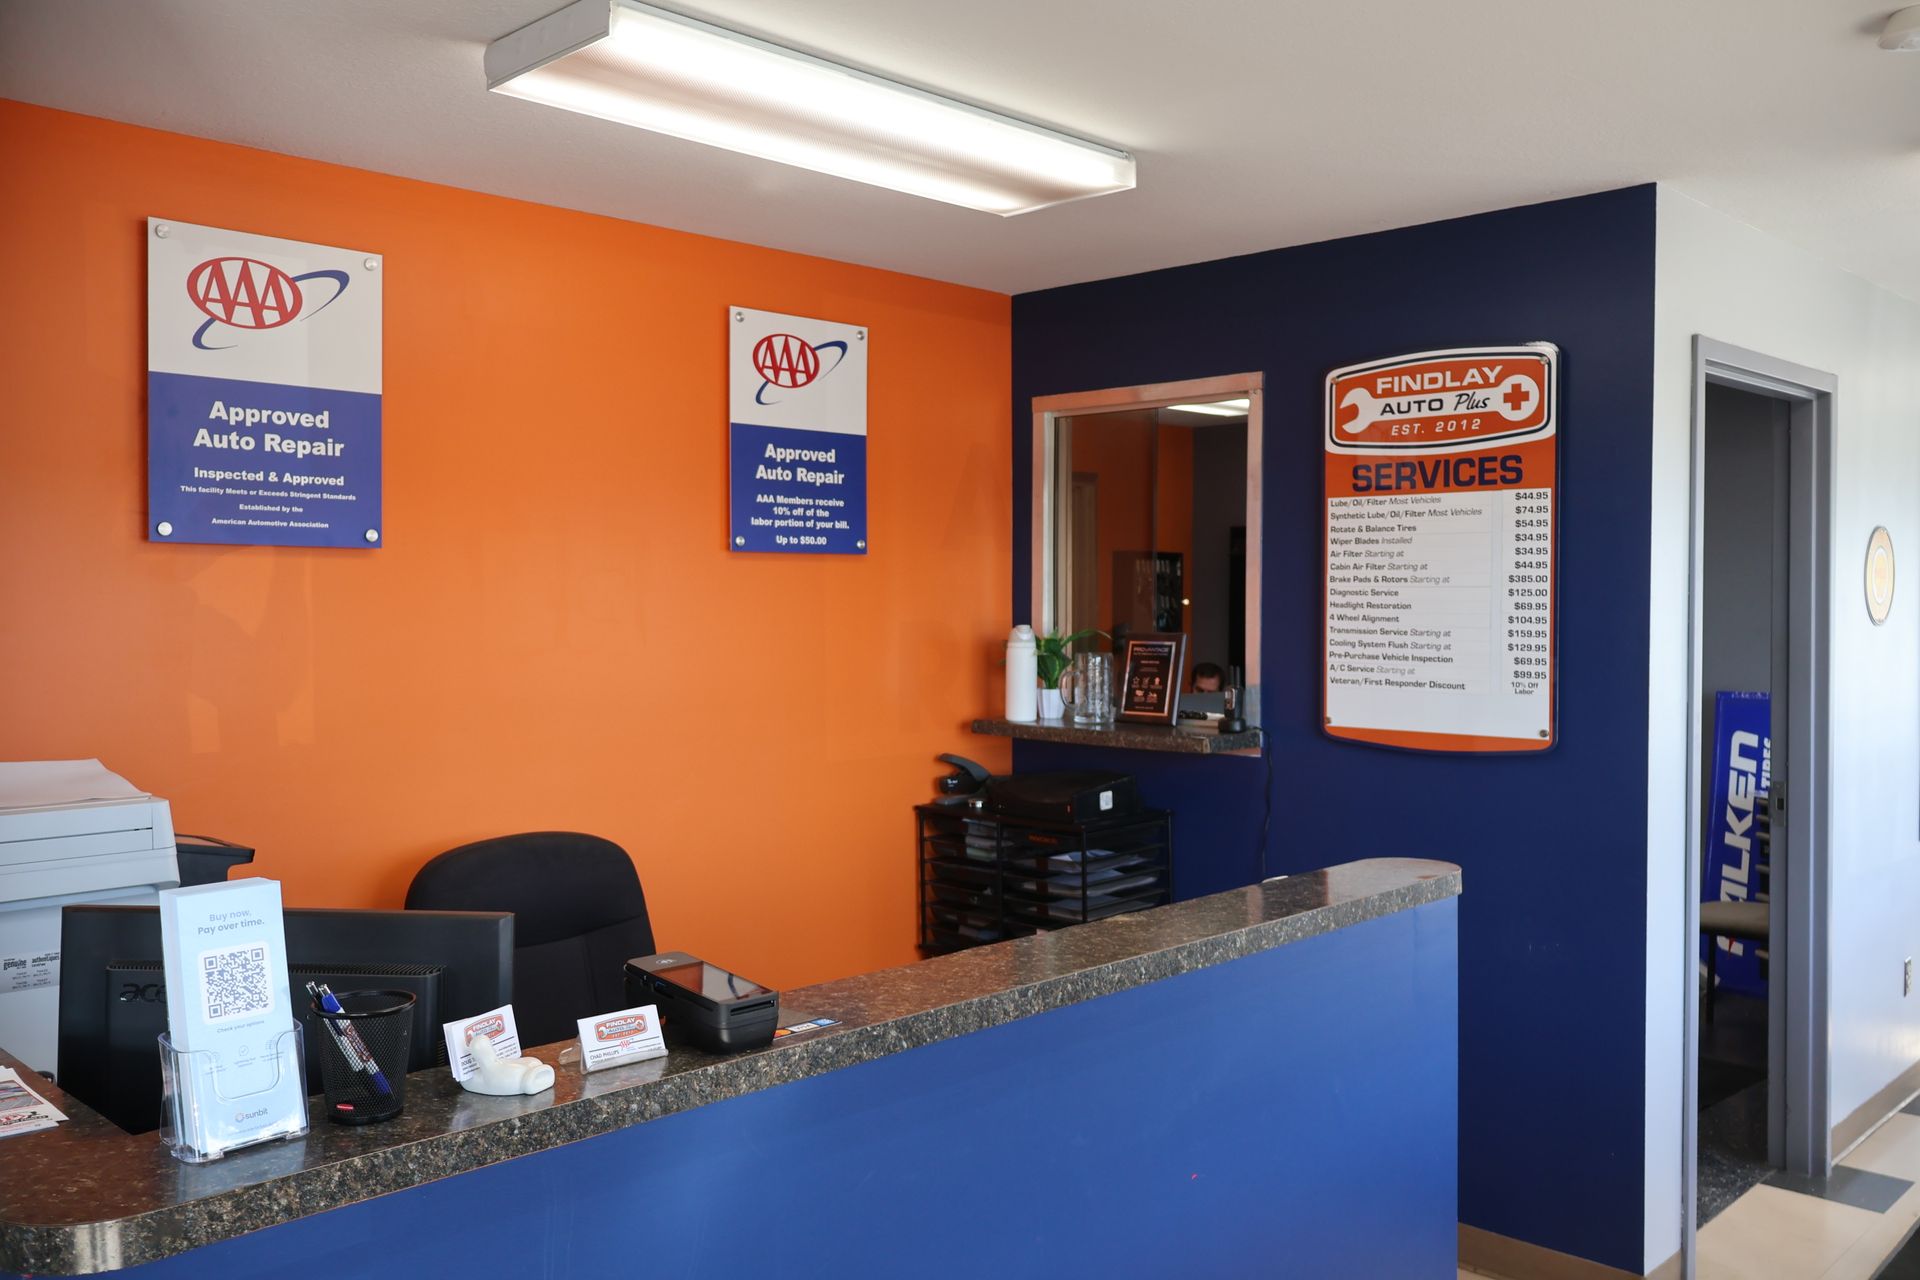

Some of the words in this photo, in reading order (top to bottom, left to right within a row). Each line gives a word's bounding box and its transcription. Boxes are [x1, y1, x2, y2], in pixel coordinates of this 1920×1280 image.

[193, 257, 297, 328] AAA
[757, 334, 816, 388] AAA
[1377, 365, 1503, 395] FINDLAY
[1380, 398, 1443, 416] AUTO
[1454, 392, 1490, 411] Plus
[209, 401, 329, 429] Approved
[1391, 422, 1425, 436] EST.
[1435, 419, 1481, 432] 2012
[193, 429, 255, 451] Auto
[264, 434, 344, 458] Repair
[765, 443, 835, 463] Approved
[194, 468, 264, 483] Inspected
[269, 471, 278, 482] &
[283, 472, 344, 486] Approved
[756, 465, 792, 481] Auto
[796, 468, 844, 486] Repair
[1352, 455, 1523, 492] SERVICES
[198, 486, 224, 496] facility
[290, 491, 320, 500] Stringent
[322, 493, 356, 501] Standards
[756, 494, 774, 504] AAA
[776, 495, 813, 506] Members
[815, 497, 844, 507] receive
[1330, 498, 1387, 507] Lube/Oil/Filter
[1388, 497, 1409, 505] Most
[1411, 496, 1441, 504] Vehicles
[1515, 491, 1548, 500] $44.95
[239, 503, 279, 512] Established
[281, 505, 290, 514] by
[773, 507, 790, 516] 10%
[792, 507, 804, 517] off
[806, 508, 814, 517] of
[816, 508, 829, 517] the
[1330, 511, 1365, 521] Synthetic
[1367, 509, 1426, 519] Lube/Oil/Filter
[1428, 509, 1449, 517] Most
[1450, 508, 1482, 516] Vehicles
[1516, 506, 1548, 514] $74.95
[212, 517, 245, 526] American
[248, 519, 287, 527] Automotive
[289, 520, 329, 528] Association
[751, 517, 773, 526] labor
[775, 518, 804, 528] portion
[806, 518, 814, 528] of
[816, 520, 833, 530] your
[835, 520, 849, 529] bill.
[1330, 525, 1356, 533] Rotate
[1515, 519, 1548, 528] $54.95
[776, 535, 787, 545] Up
[790, 536, 798, 545] to
[800, 536, 827, 545] $50.00
[1330, 538, 1353, 546] Wiper
[1355, 537, 1379, 545] Blades
[1381, 536, 1412, 544] Installed
[1515, 533, 1548, 542] $34.95
[1330, 550, 1341, 558] Air
[1365, 550, 1394, 559] Starting
[1515, 547, 1548, 556] $34.95
[1330, 563, 1350, 571] Cabin
[1387, 563, 1418, 572] Starting
[1515, 561, 1548, 570] $44.95
[1410, 576, 1440, 584] Starting
[1508, 575, 1548, 583] $385.00
[1330, 589, 1368, 598] Diagnostic
[1371, 589, 1399, 597] Service
[1508, 589, 1547, 597] $125.00
[1330, 601, 1363, 610] Headlight
[1366, 602, 1411, 610] Restoration
[1514, 602, 1547, 611] $69.95
[1337, 614, 1360, 622] Wheel
[1362, 615, 1399, 624] Alignment
[1508, 616, 1547, 624] $104.95
[1330, 627, 1378, 636] Transmission
[1380, 628, 1408, 636] Service
[1410, 629, 1441, 638] Starting
[1508, 629, 1547, 638] $159.95
[1330, 639, 1356, 649] Cooling
[1358, 640, 1386, 650] System
[1388, 641, 1408, 649] Flush
[1410, 642, 1441, 651] Starting
[1508, 643, 1547, 652] $129.95
[1329, 652, 1380, 661] Pre-Purchase
[1382, 653, 1409, 662] Vehicle
[1411, 654, 1453, 664] Inspection
[1514, 657, 1547, 666] $69.95
[1330, 665, 1345, 673] A/C
[1347, 665, 1374, 673] Service
[1376, 665, 1405, 675] Starting
[1513, 670, 1546, 679] $99.95
[1330, 677, 1382, 686] Veteran/First
[1385, 679, 1427, 689] Responder
[1429, 681, 1465, 690] Discount
[1716, 730, 1759, 957] LKEN
[209, 912, 227, 923] Buy
[229, 909, 252, 919] now.
[197, 926, 216, 936] Pay
[218, 922, 239, 933] over
[241, 918, 265, 931] time.
[119, 983, 167, 1003] ace
[245, 1107, 268, 1120] sunbit
